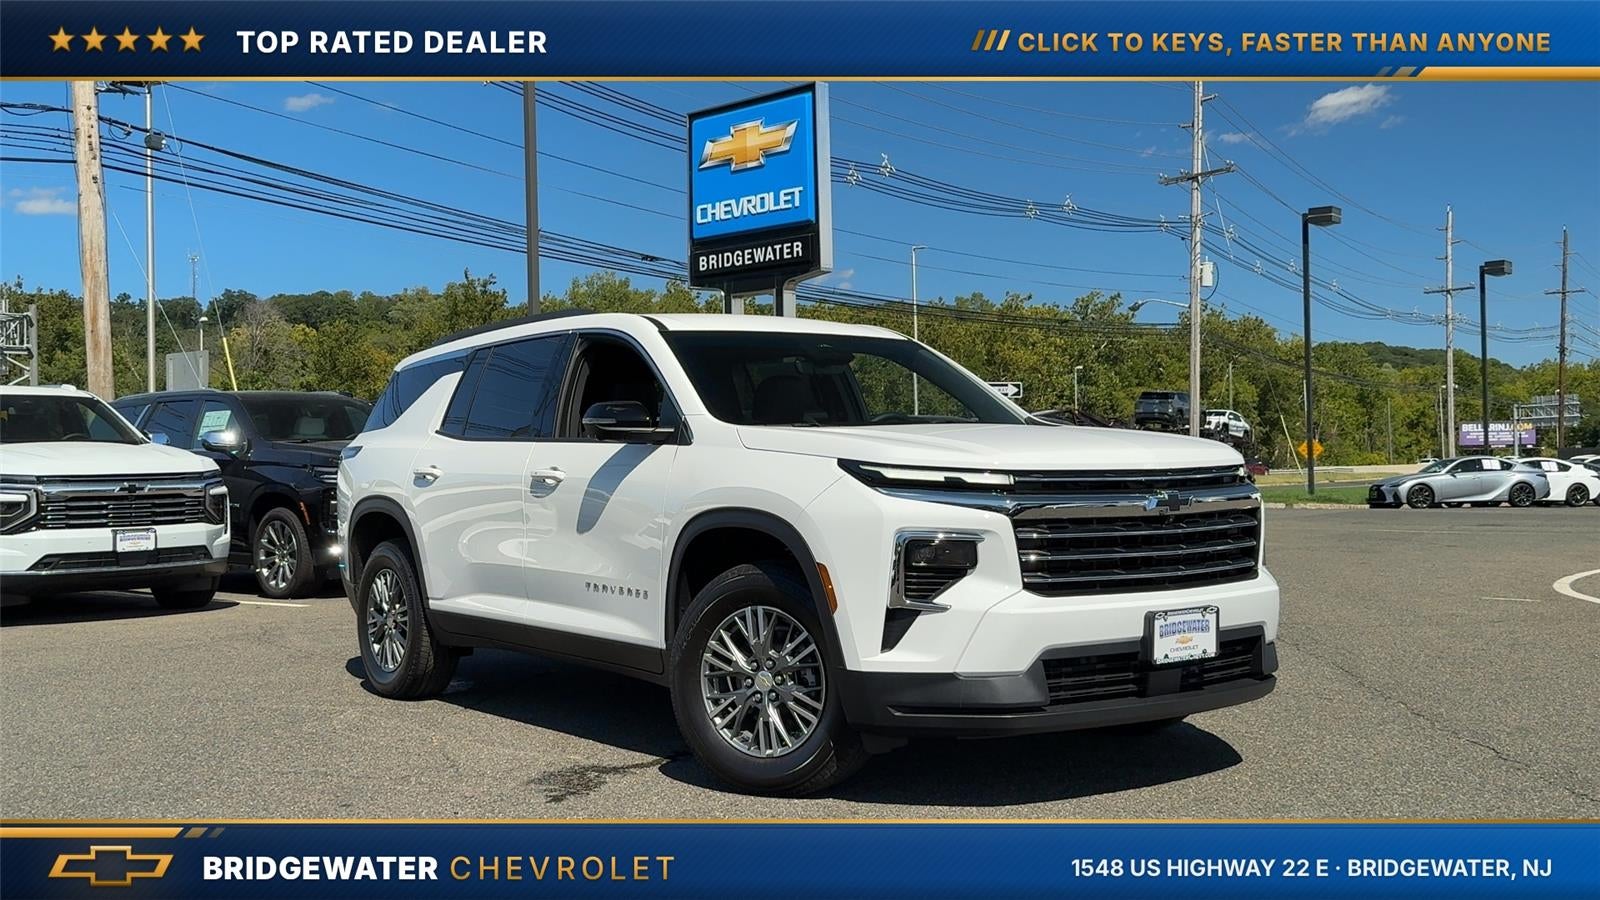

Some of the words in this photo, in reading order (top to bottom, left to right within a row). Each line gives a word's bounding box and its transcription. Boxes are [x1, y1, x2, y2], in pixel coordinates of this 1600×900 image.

[696, 186, 804, 225] CHEVROLET
[699, 241, 803, 271] BRIDGEWATER
[1159, 619, 1210, 639] BRIDGEWATER
